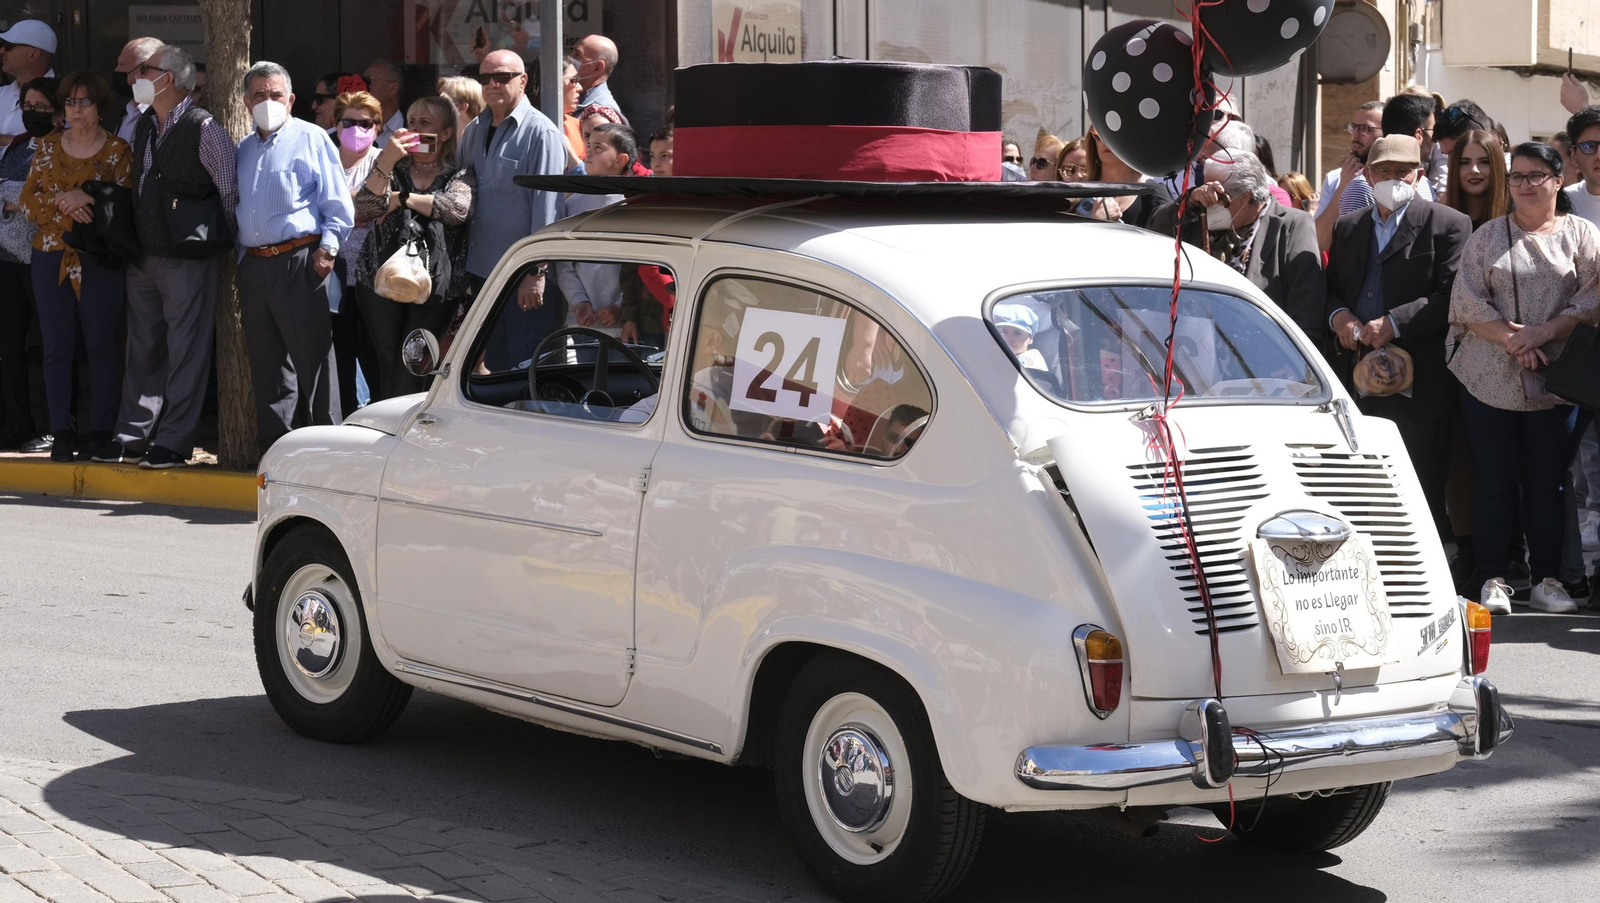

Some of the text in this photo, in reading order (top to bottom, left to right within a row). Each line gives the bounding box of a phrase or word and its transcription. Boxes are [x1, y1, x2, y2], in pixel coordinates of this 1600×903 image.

[136, 14, 202, 22] NO FIJAR CARTELES
[741, 24, 796, 62] Alquila
[745, 331, 821, 407] 24
[1282, 566, 1360, 587] Lo importante
[1295, 591, 1358, 611] no es Llegar
[1314, 617, 1353, 635] sino IR
